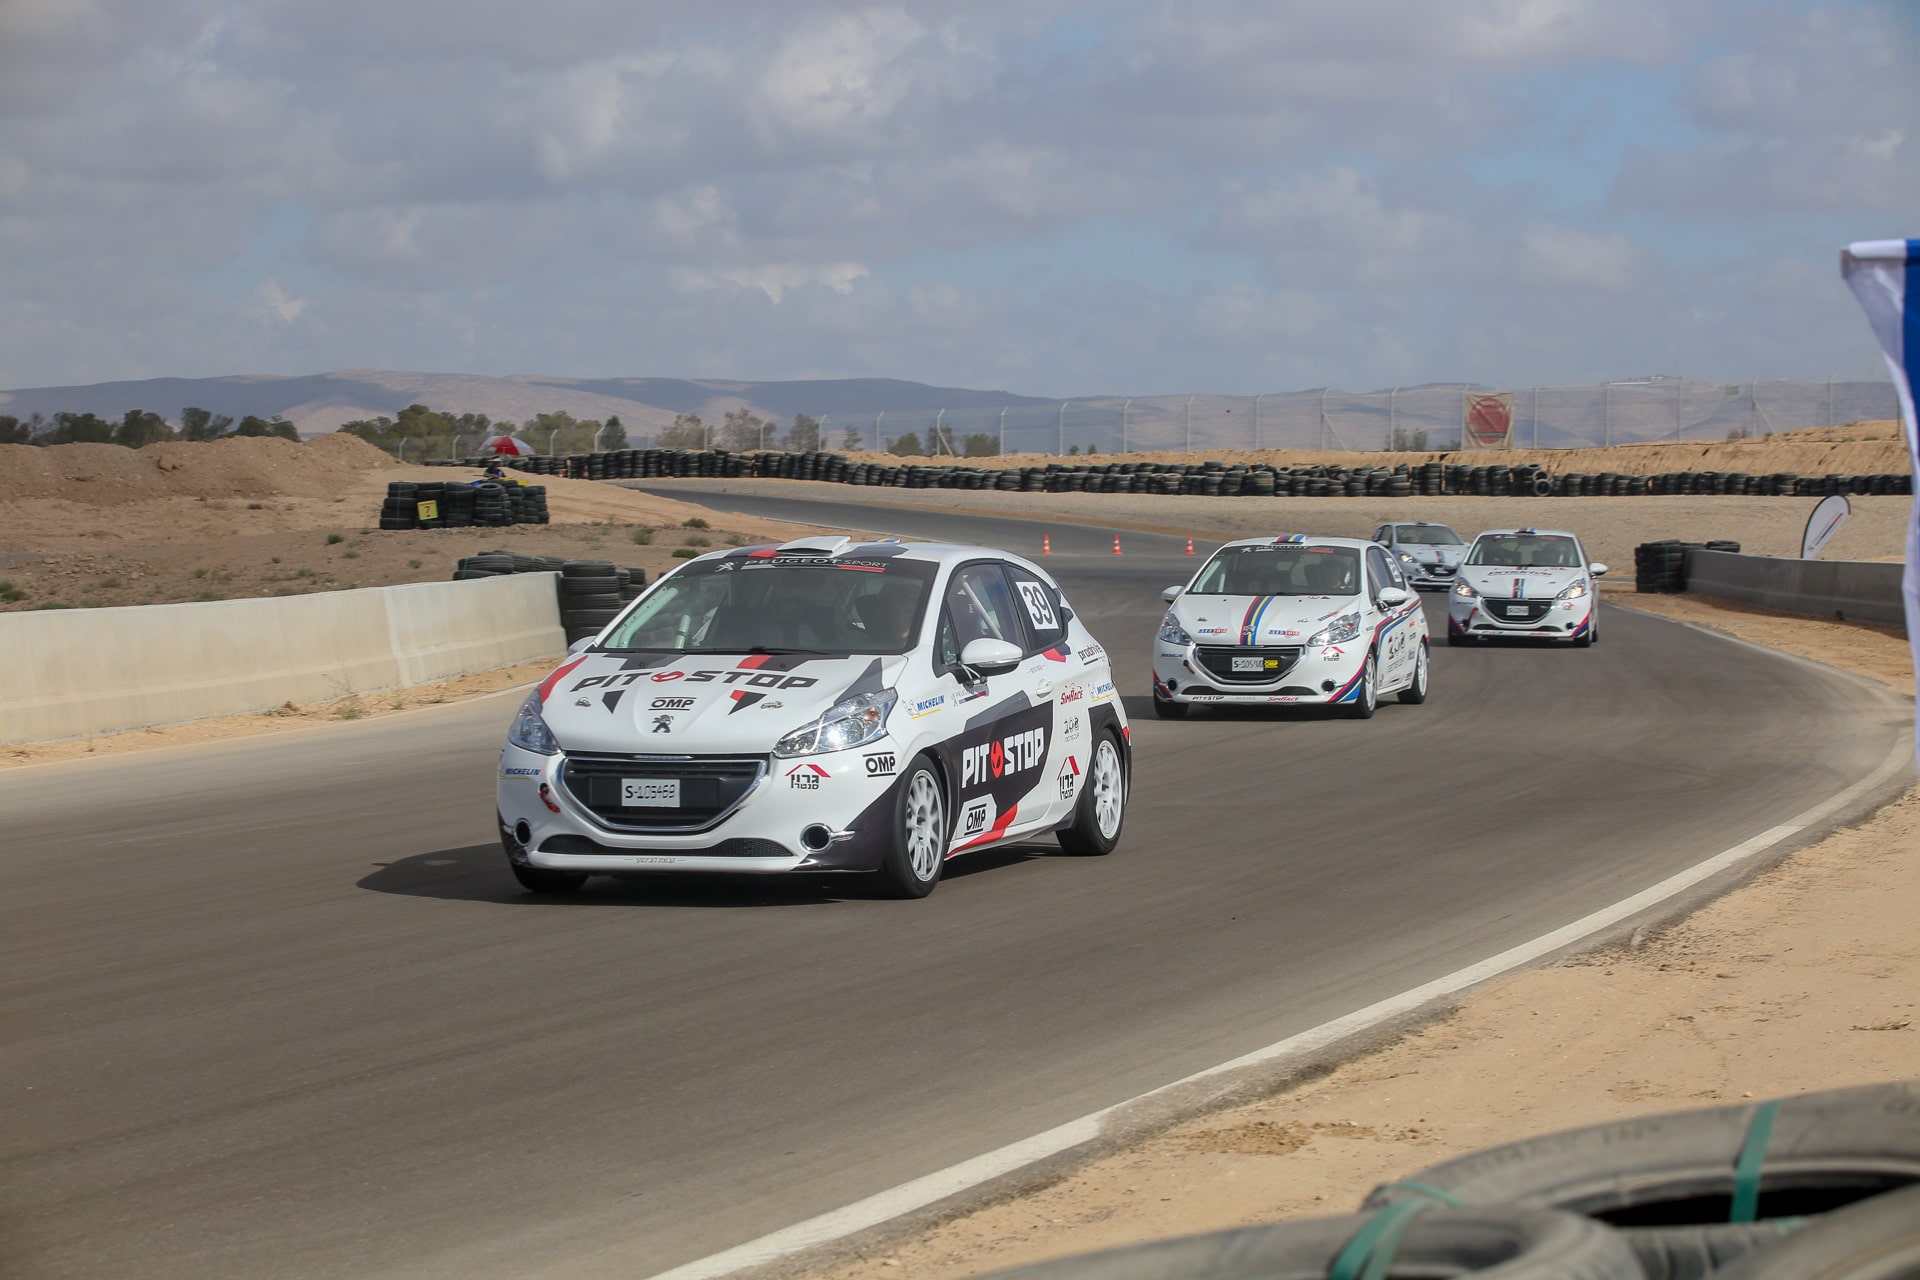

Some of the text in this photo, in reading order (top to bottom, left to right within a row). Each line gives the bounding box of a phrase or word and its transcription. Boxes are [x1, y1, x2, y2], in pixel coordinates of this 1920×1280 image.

[845, 559, 890, 568] SPORT
[1023, 586, 1052, 625] 39
[570, 670, 819, 692] PIT STOP
[651, 699, 694, 708] OMP
[917, 695, 945, 711] MICHELIN
[865, 755, 895, 773] OMP
[962, 728, 1044, 788] PIT STOP
[506, 768, 540, 776] MICHELIN
[966, 808, 986, 831] OMP
